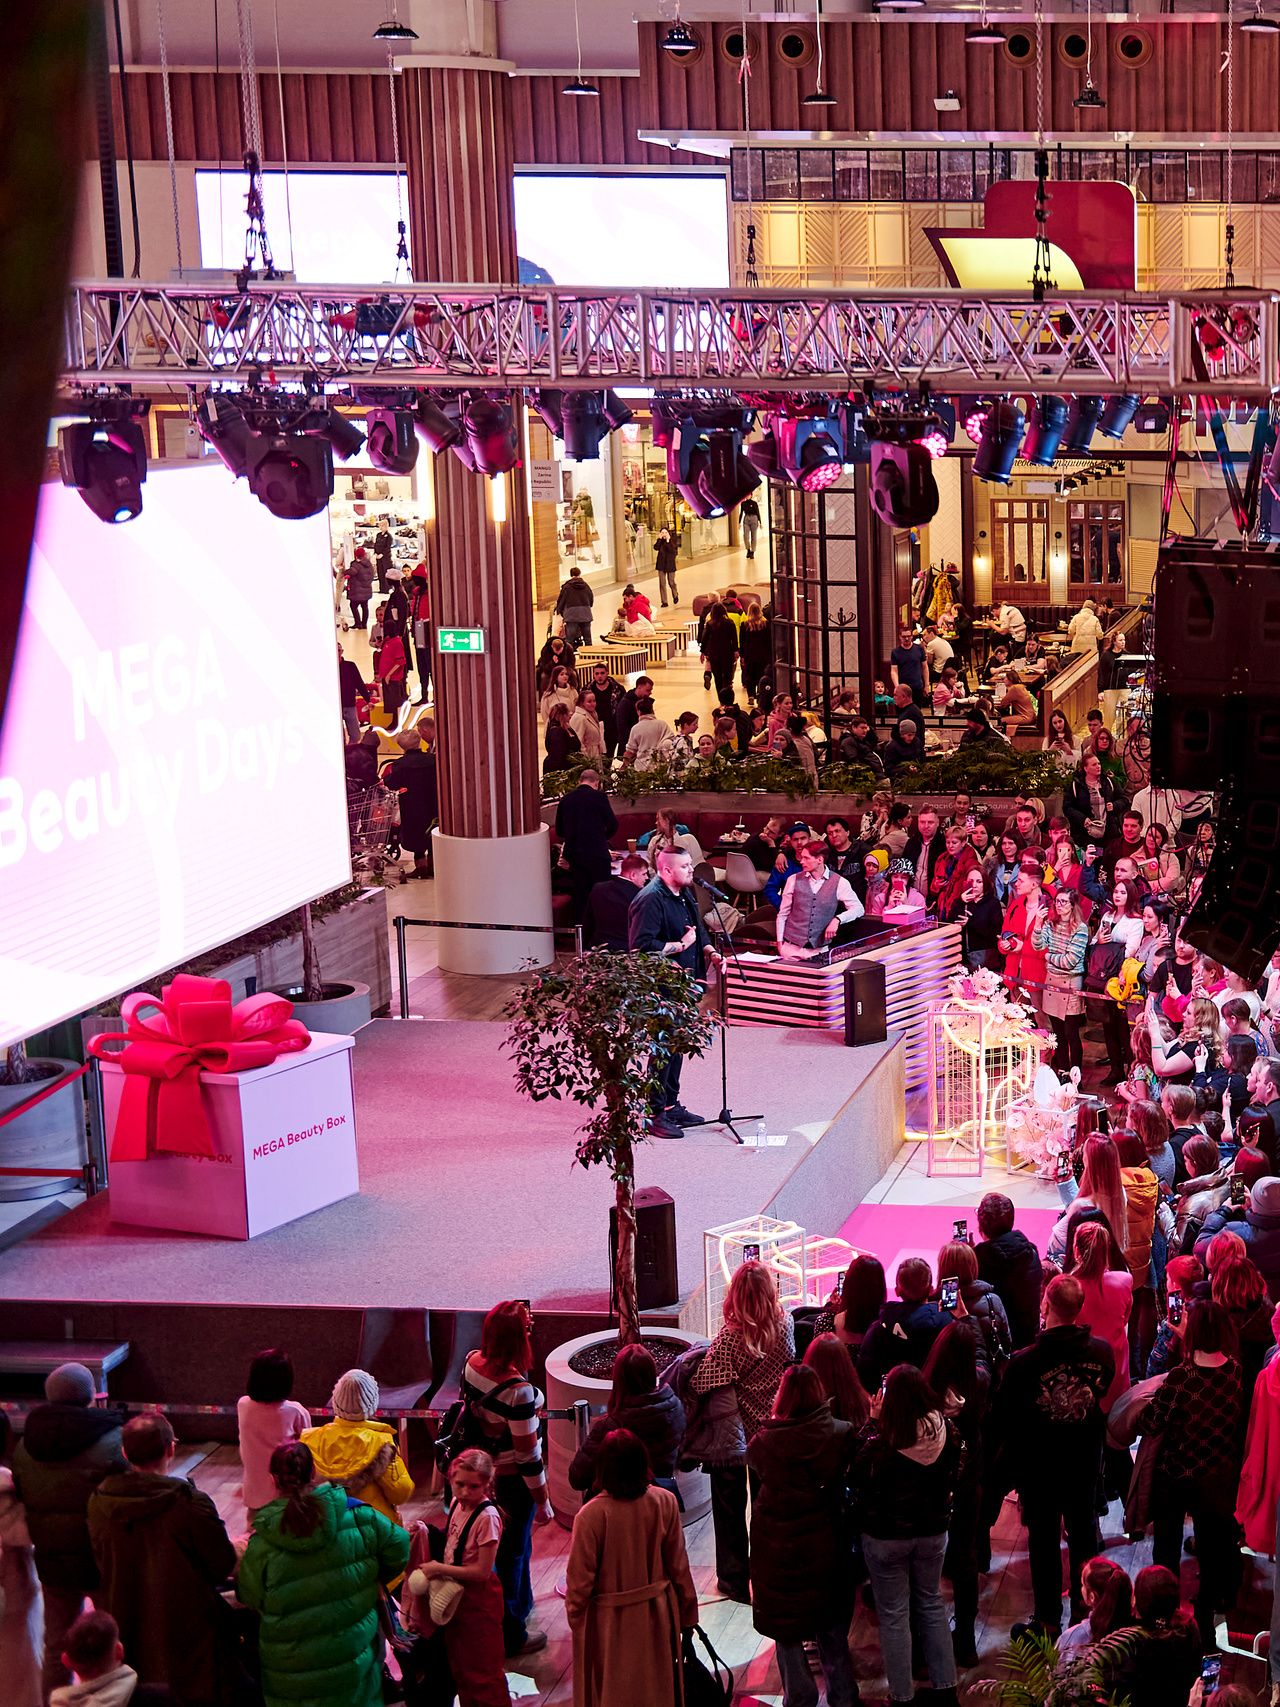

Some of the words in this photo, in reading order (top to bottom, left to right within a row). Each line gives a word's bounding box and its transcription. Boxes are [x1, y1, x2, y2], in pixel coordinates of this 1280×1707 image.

[70, 627, 228, 742] MEGA
[0, 747, 185, 868] Beauty
[195, 711, 304, 796] Days
[253, 1137, 285, 1160] MEGA
[286, 1122, 324, 1145] Beauty
[326, 1115, 346, 1130] Box
